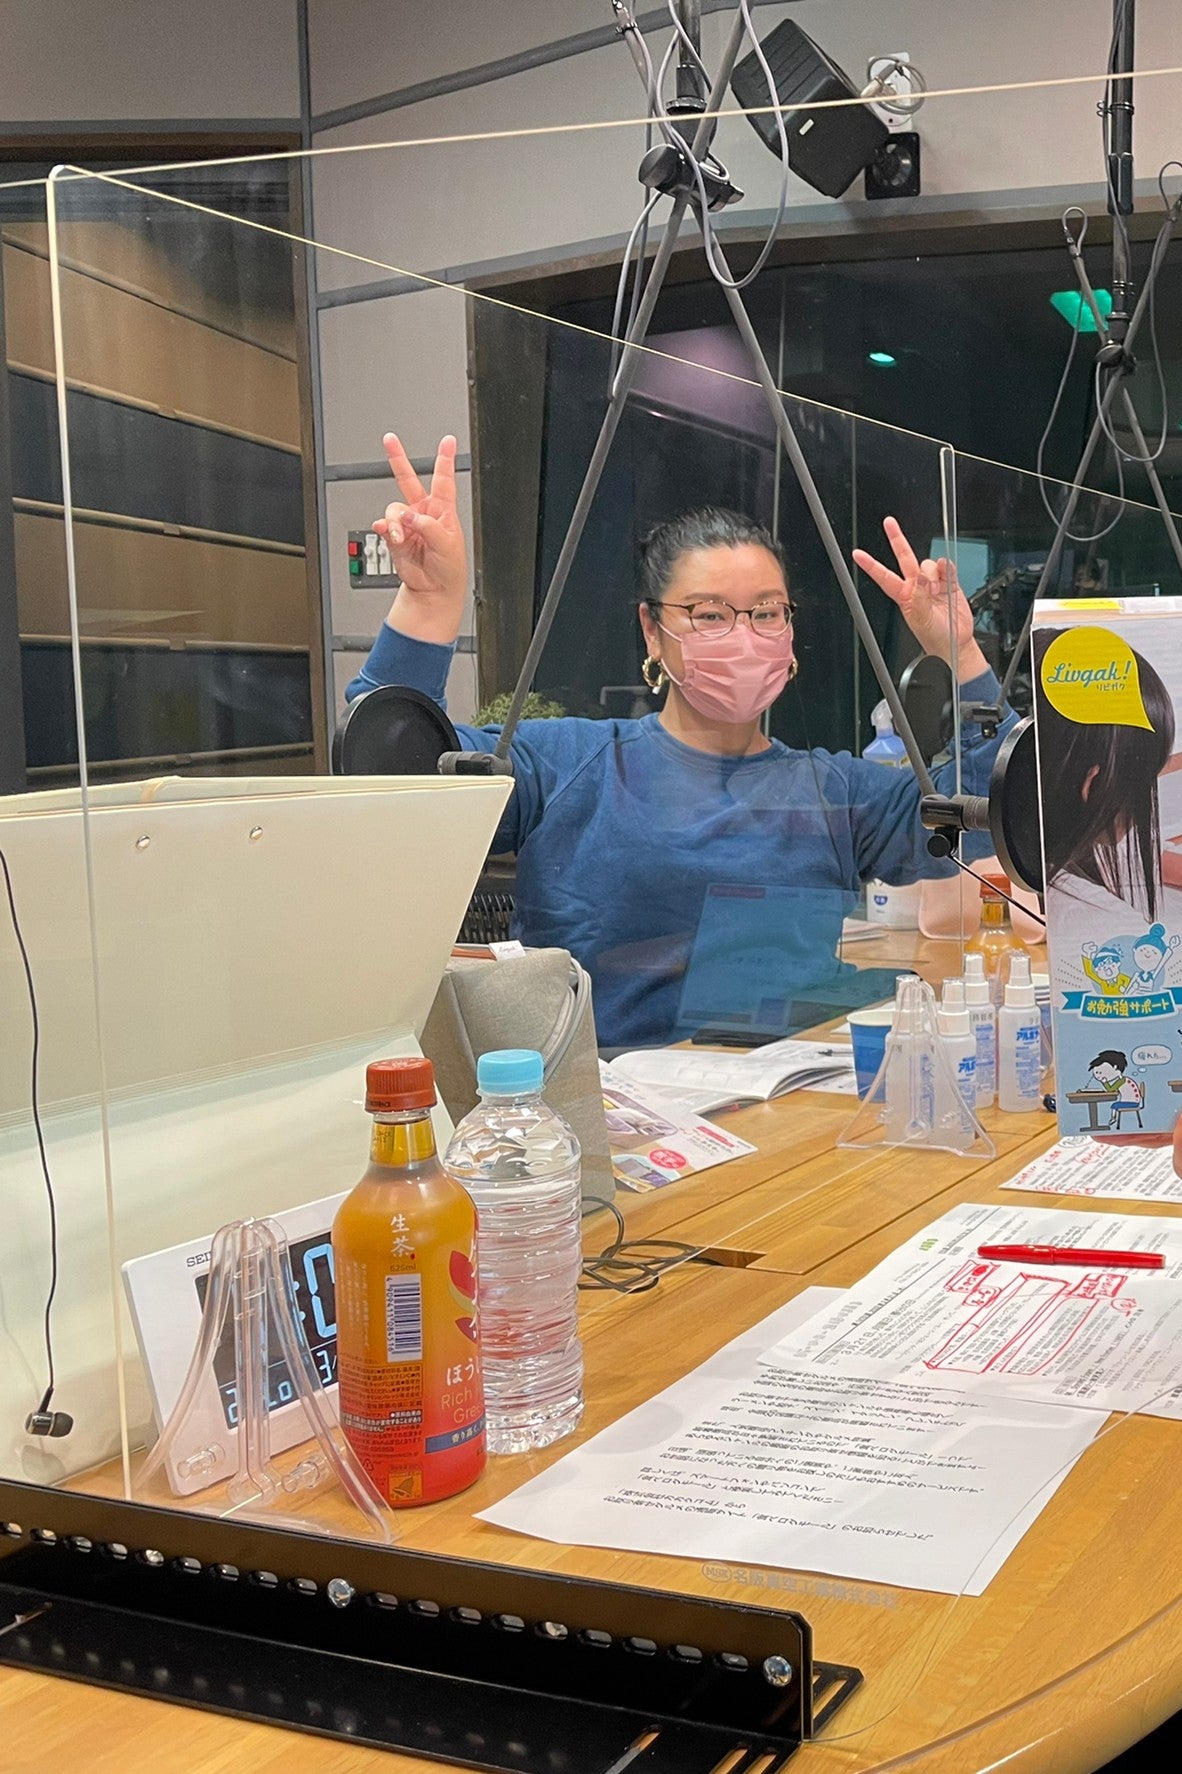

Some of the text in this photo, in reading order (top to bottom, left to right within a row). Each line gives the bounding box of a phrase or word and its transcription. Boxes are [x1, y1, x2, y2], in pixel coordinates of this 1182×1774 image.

[1047, 660, 1132, 689] Livgak!
[1086, 998, 1169, 1017] お勉強サポート
[390, 1213, 415, 1258] 生茶
[441, 1387, 472, 1410] Rich
